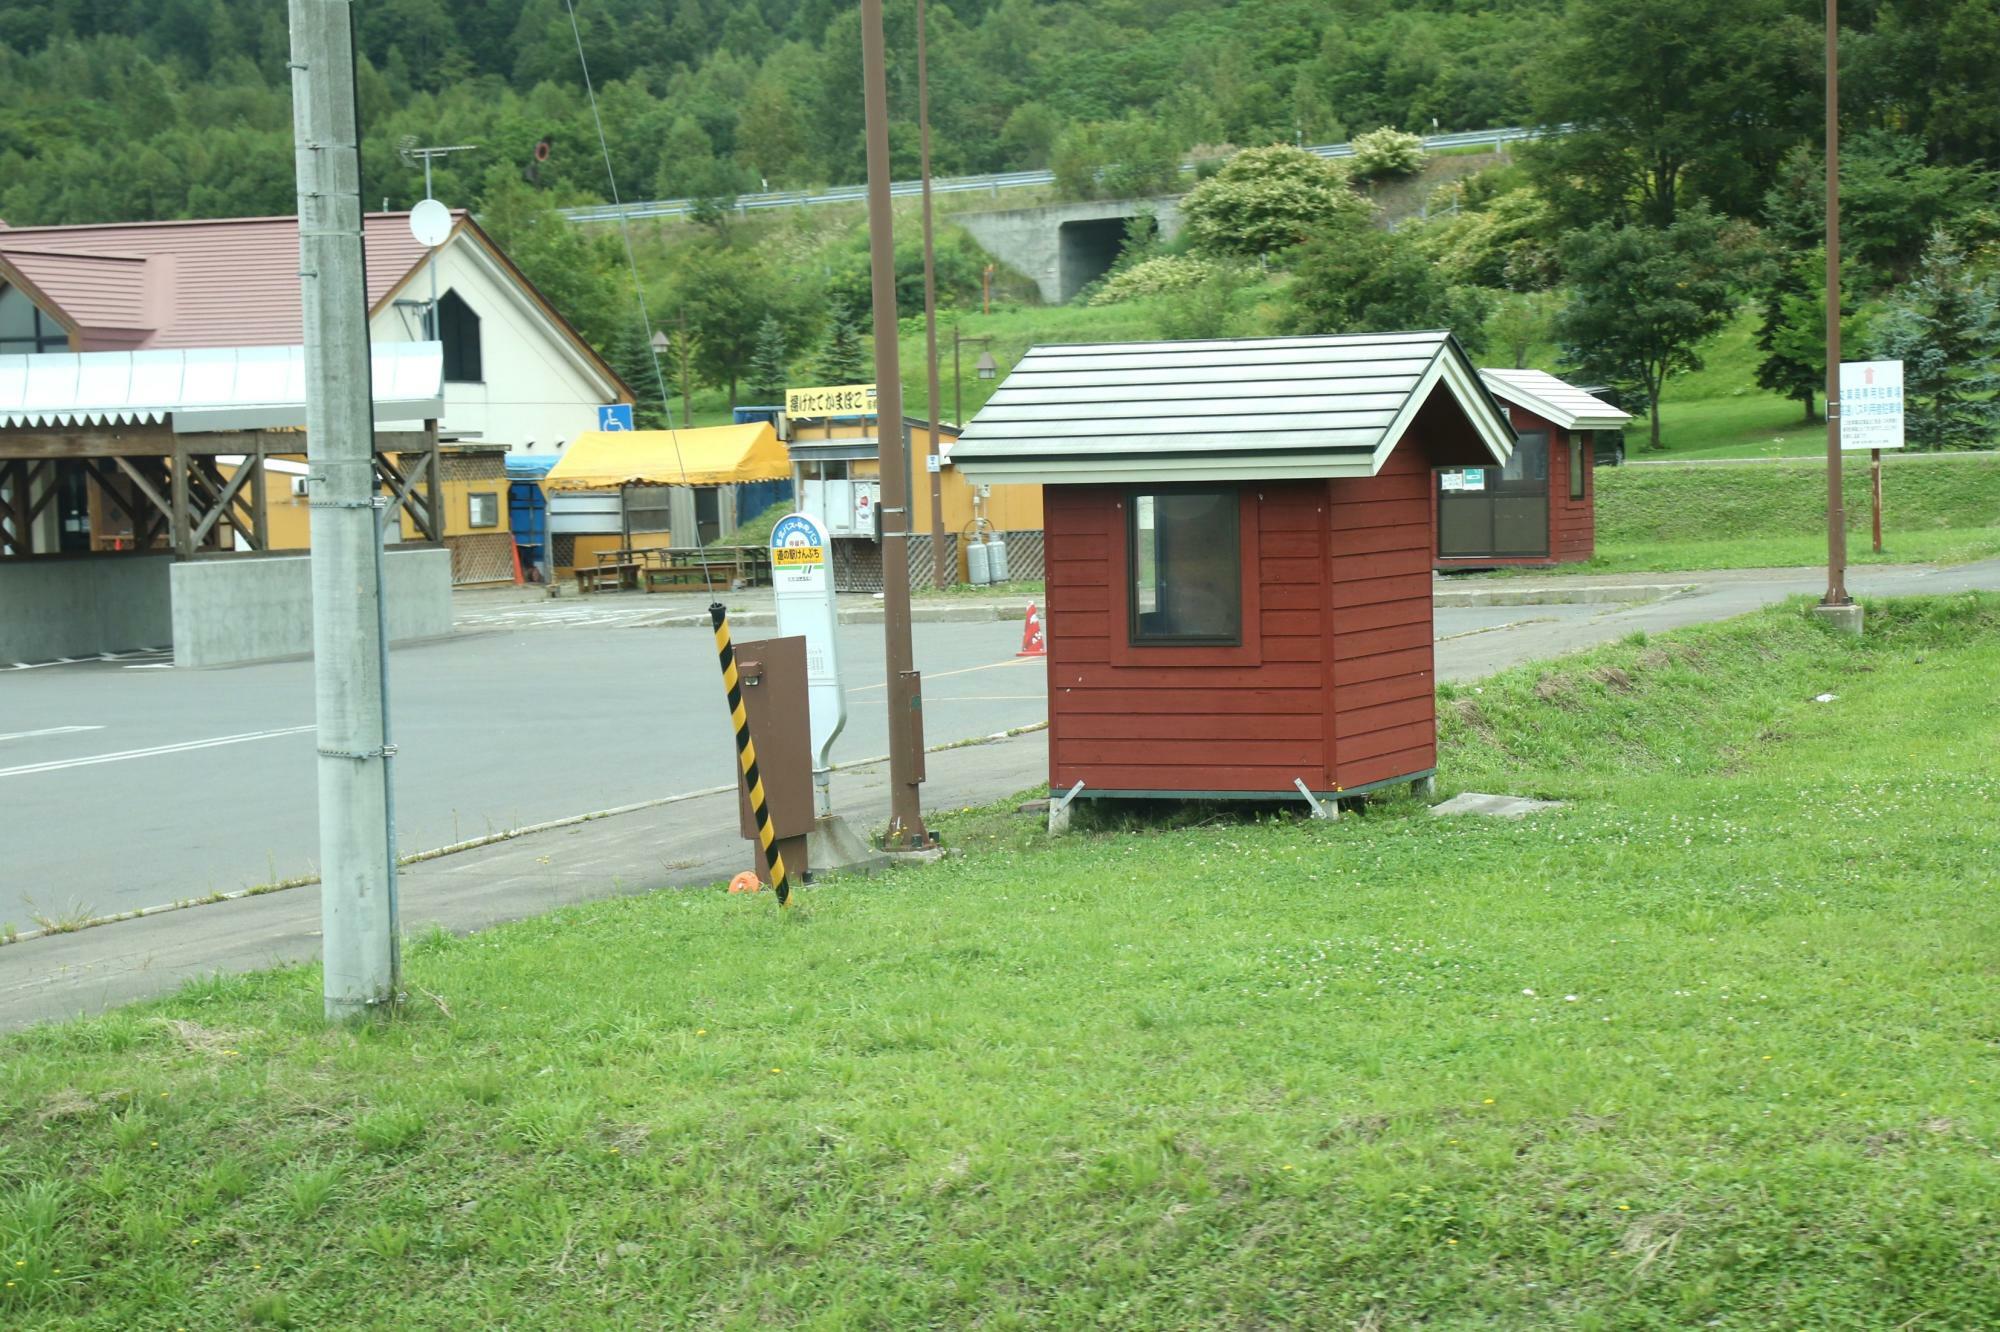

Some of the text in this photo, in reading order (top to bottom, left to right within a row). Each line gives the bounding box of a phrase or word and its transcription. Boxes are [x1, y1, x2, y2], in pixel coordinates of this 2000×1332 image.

[777, 549, 820, 561] 道の駅けんぶち
